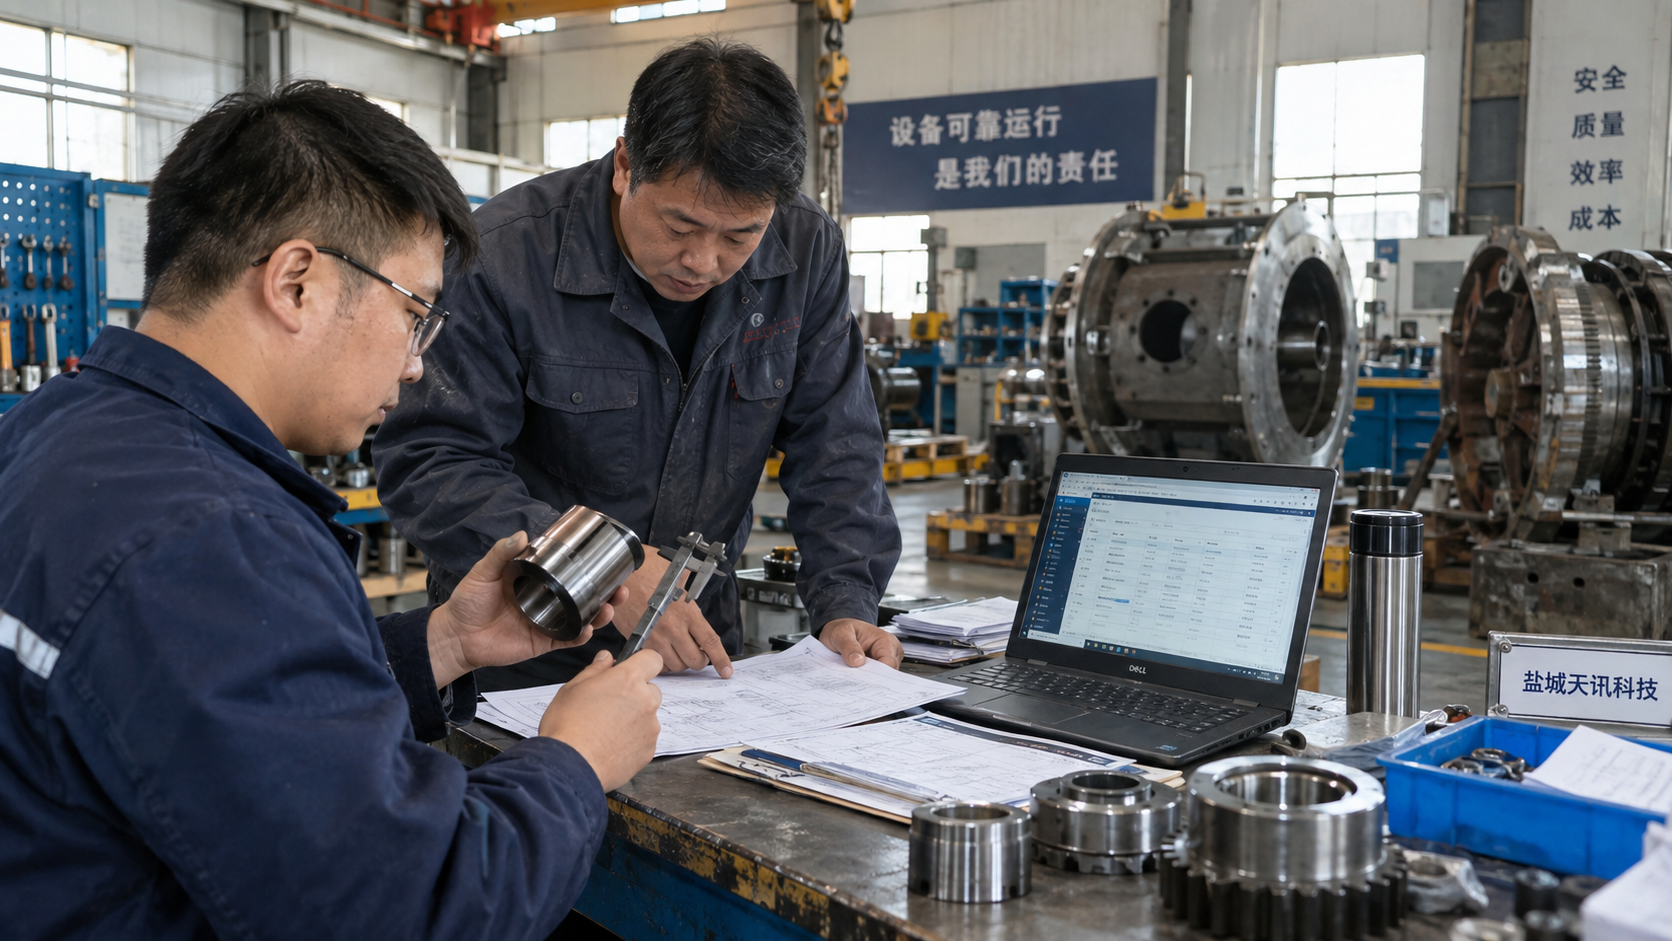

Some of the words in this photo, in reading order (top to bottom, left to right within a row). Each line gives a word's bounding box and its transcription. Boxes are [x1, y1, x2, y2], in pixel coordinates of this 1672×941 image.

[1574, 65, 1626, 93] 安全
[890, 105, 1062, 147] 设备可靠运行
[1572, 111, 1625, 139] 质量
[934, 149, 1118, 190] 是我们的责任
[1570, 158, 1623, 186] 效率
[1568, 204, 1621, 231] 成本
[1129, 664, 1147, 674] DELL
[1522, 670, 1658, 701] 盐城天讯科技
